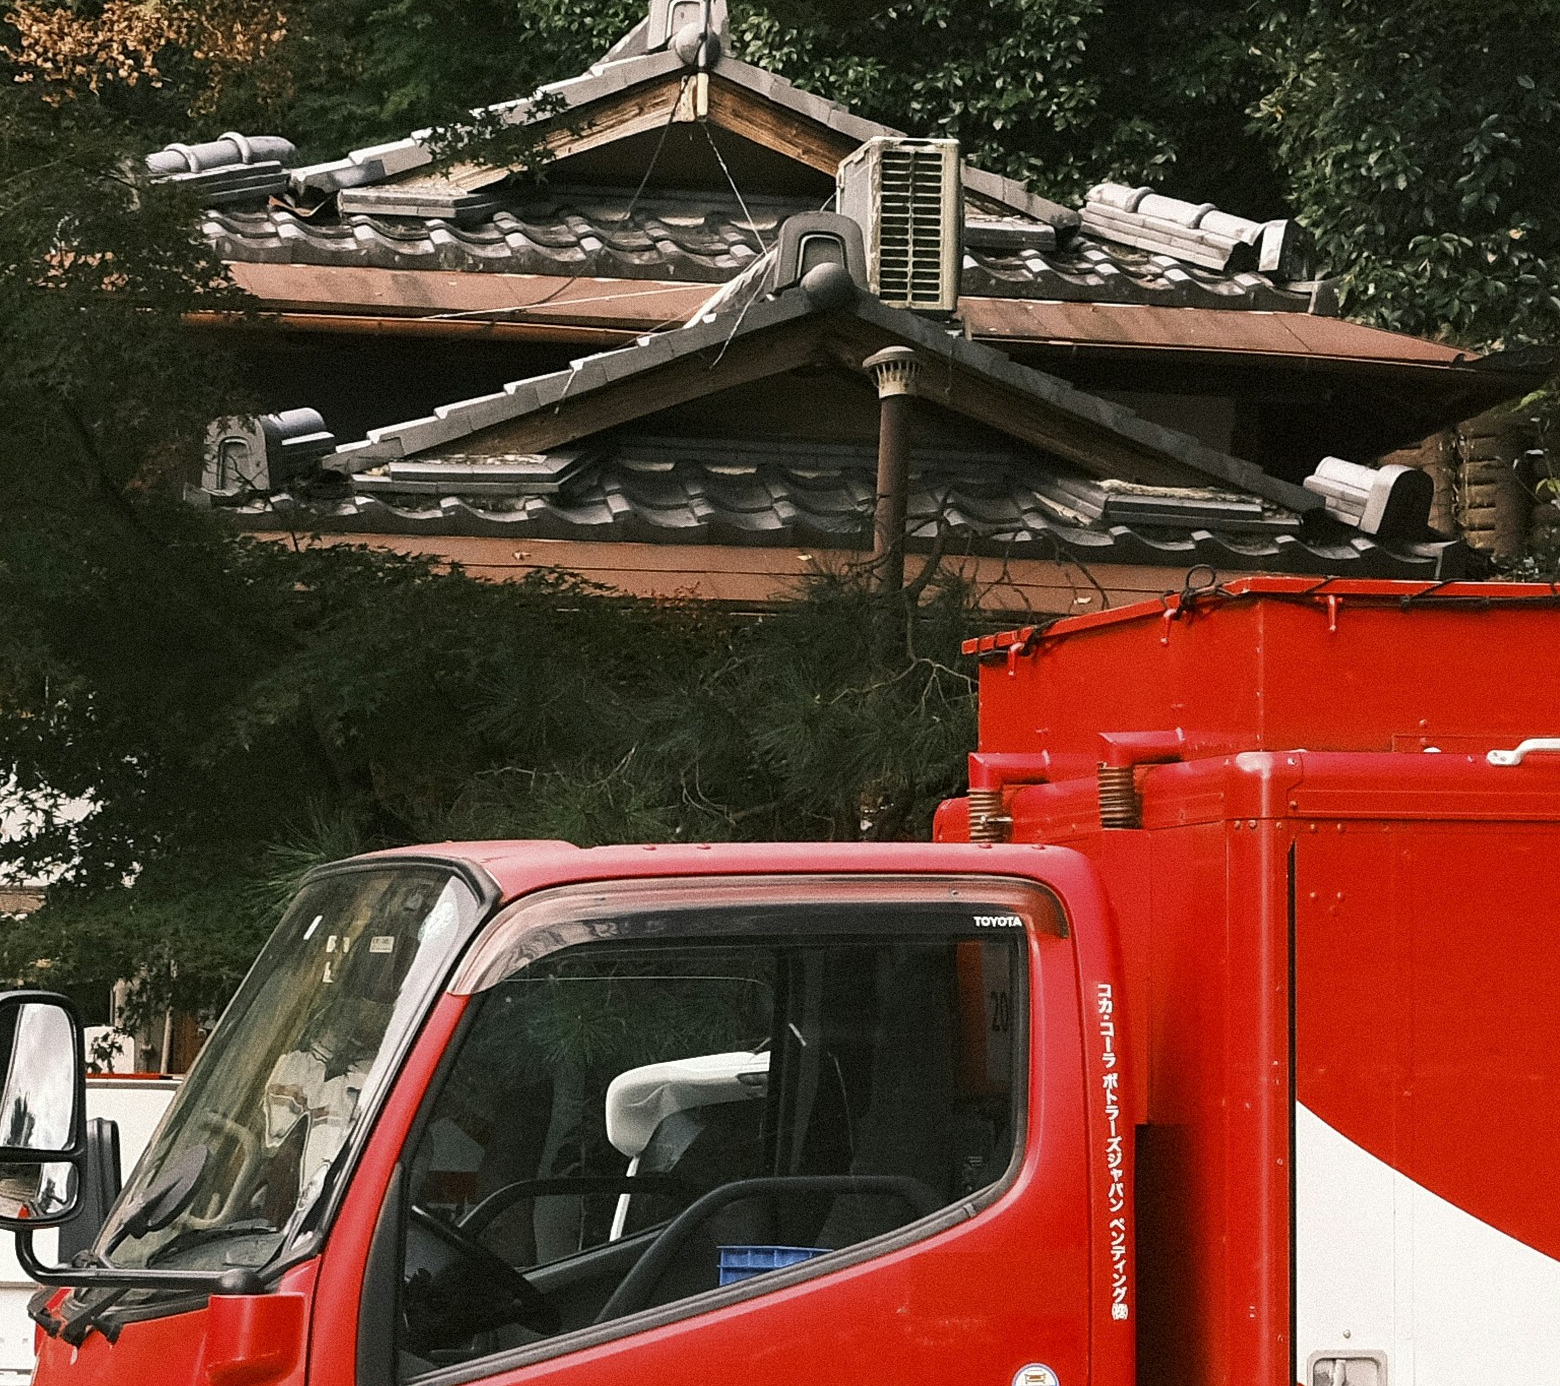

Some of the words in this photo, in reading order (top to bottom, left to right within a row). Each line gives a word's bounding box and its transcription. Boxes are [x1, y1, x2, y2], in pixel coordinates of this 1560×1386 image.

[973, 916, 1023, 928] TOYOTA
[1097, 984, 1117, 1068] コカ・コーラ
